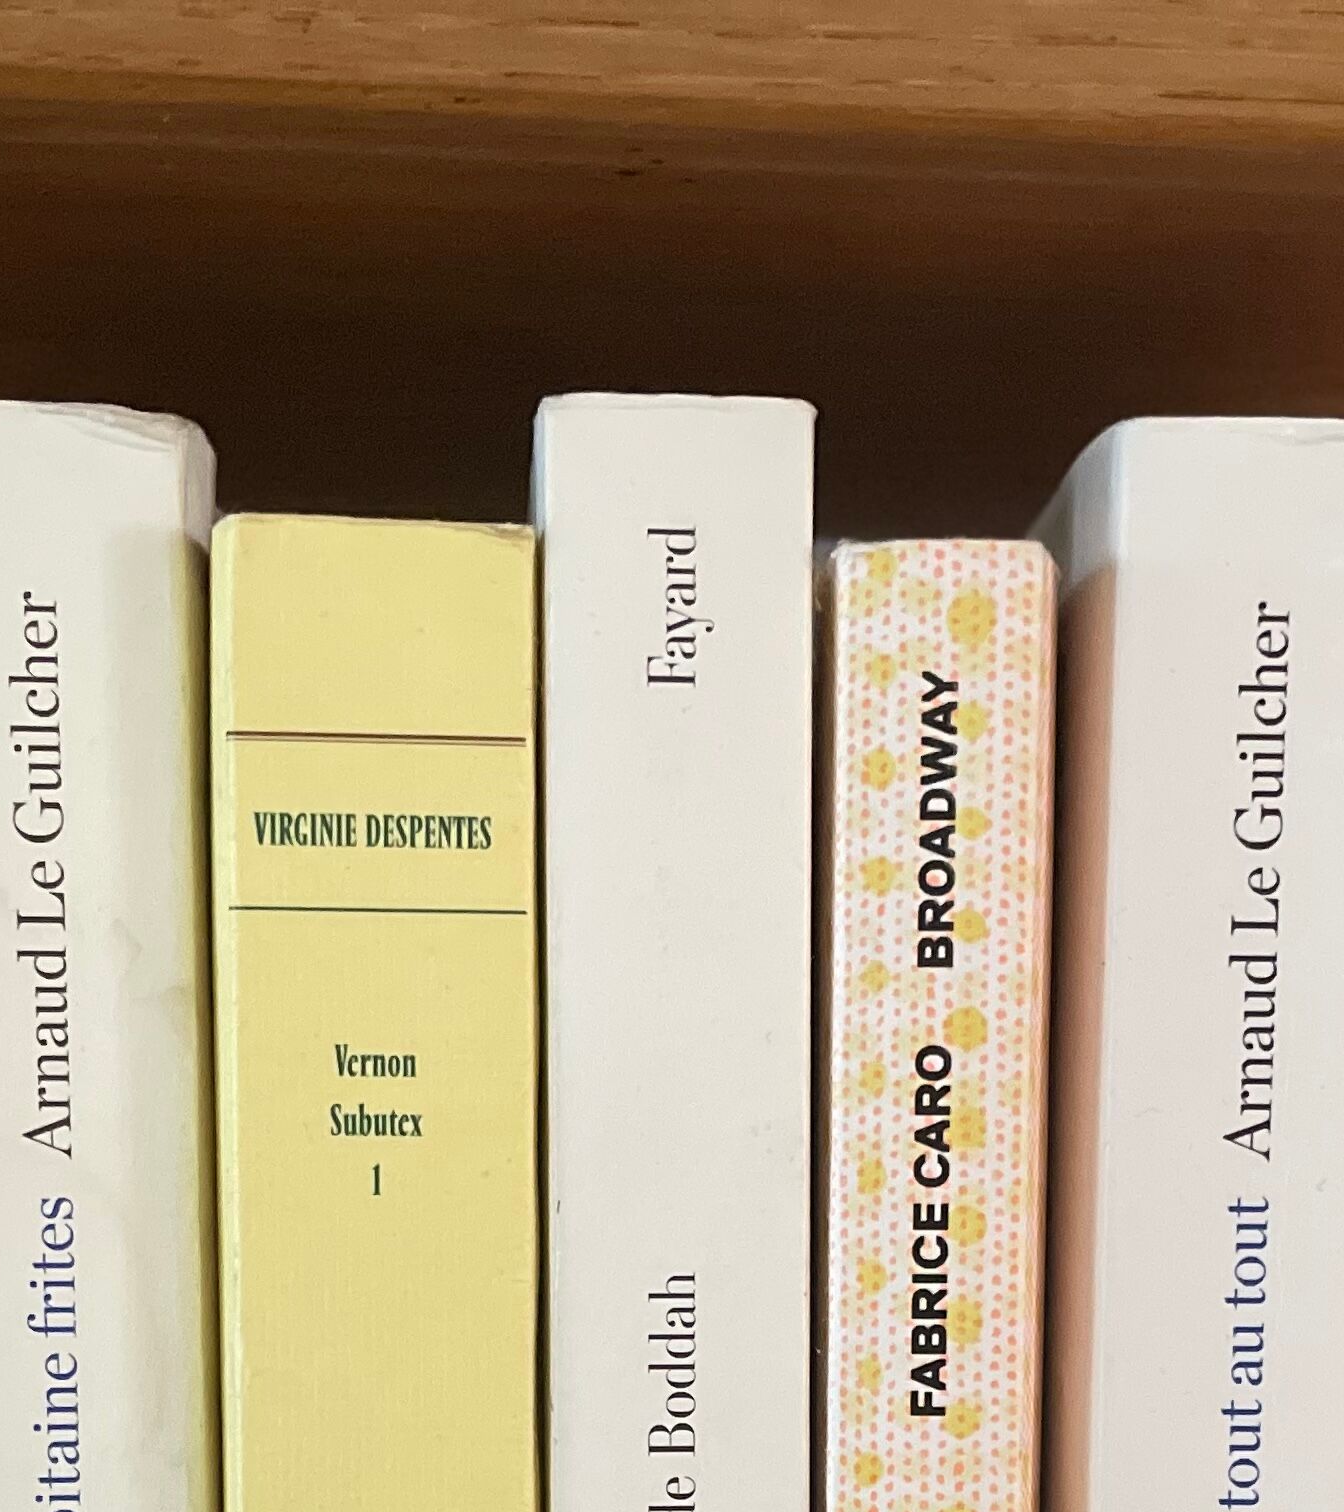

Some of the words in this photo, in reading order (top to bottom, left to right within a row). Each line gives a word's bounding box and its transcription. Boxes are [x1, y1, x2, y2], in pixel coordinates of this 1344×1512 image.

[645, 526, 716, 687] Fayard
[6, 589, 66, 845] Guilcher
[1232, 600, 1291, 852] Guilcher
[252, 810, 359, 849] VIRGINIE
[364, 812, 493, 851] DESPENTES
[916, 670, 959, 969] BROADWAY
[15, 859, 68, 932] Le
[1229, 865, 1282, 938] Le
[15, 945, 74, 1161] Arnaud
[328, 1102, 424, 1138] Subutex
[333, 1042, 418, 1079] Vernon
[912, 1044, 953, 1189] CARO
[1221, 950, 1279, 1164] Arnaud
[370, 1161, 383, 1198] 1
[25, 1195, 78, 1339] frites
[909, 1202, 950, 1418] FABRICE
[646, 1271, 698, 1457] Boddah
[1229, 1321, 1266, 1388] au
[1217, 1398, 1264, 1512] tout
[1217, 1398, 1264, 1512] tout
